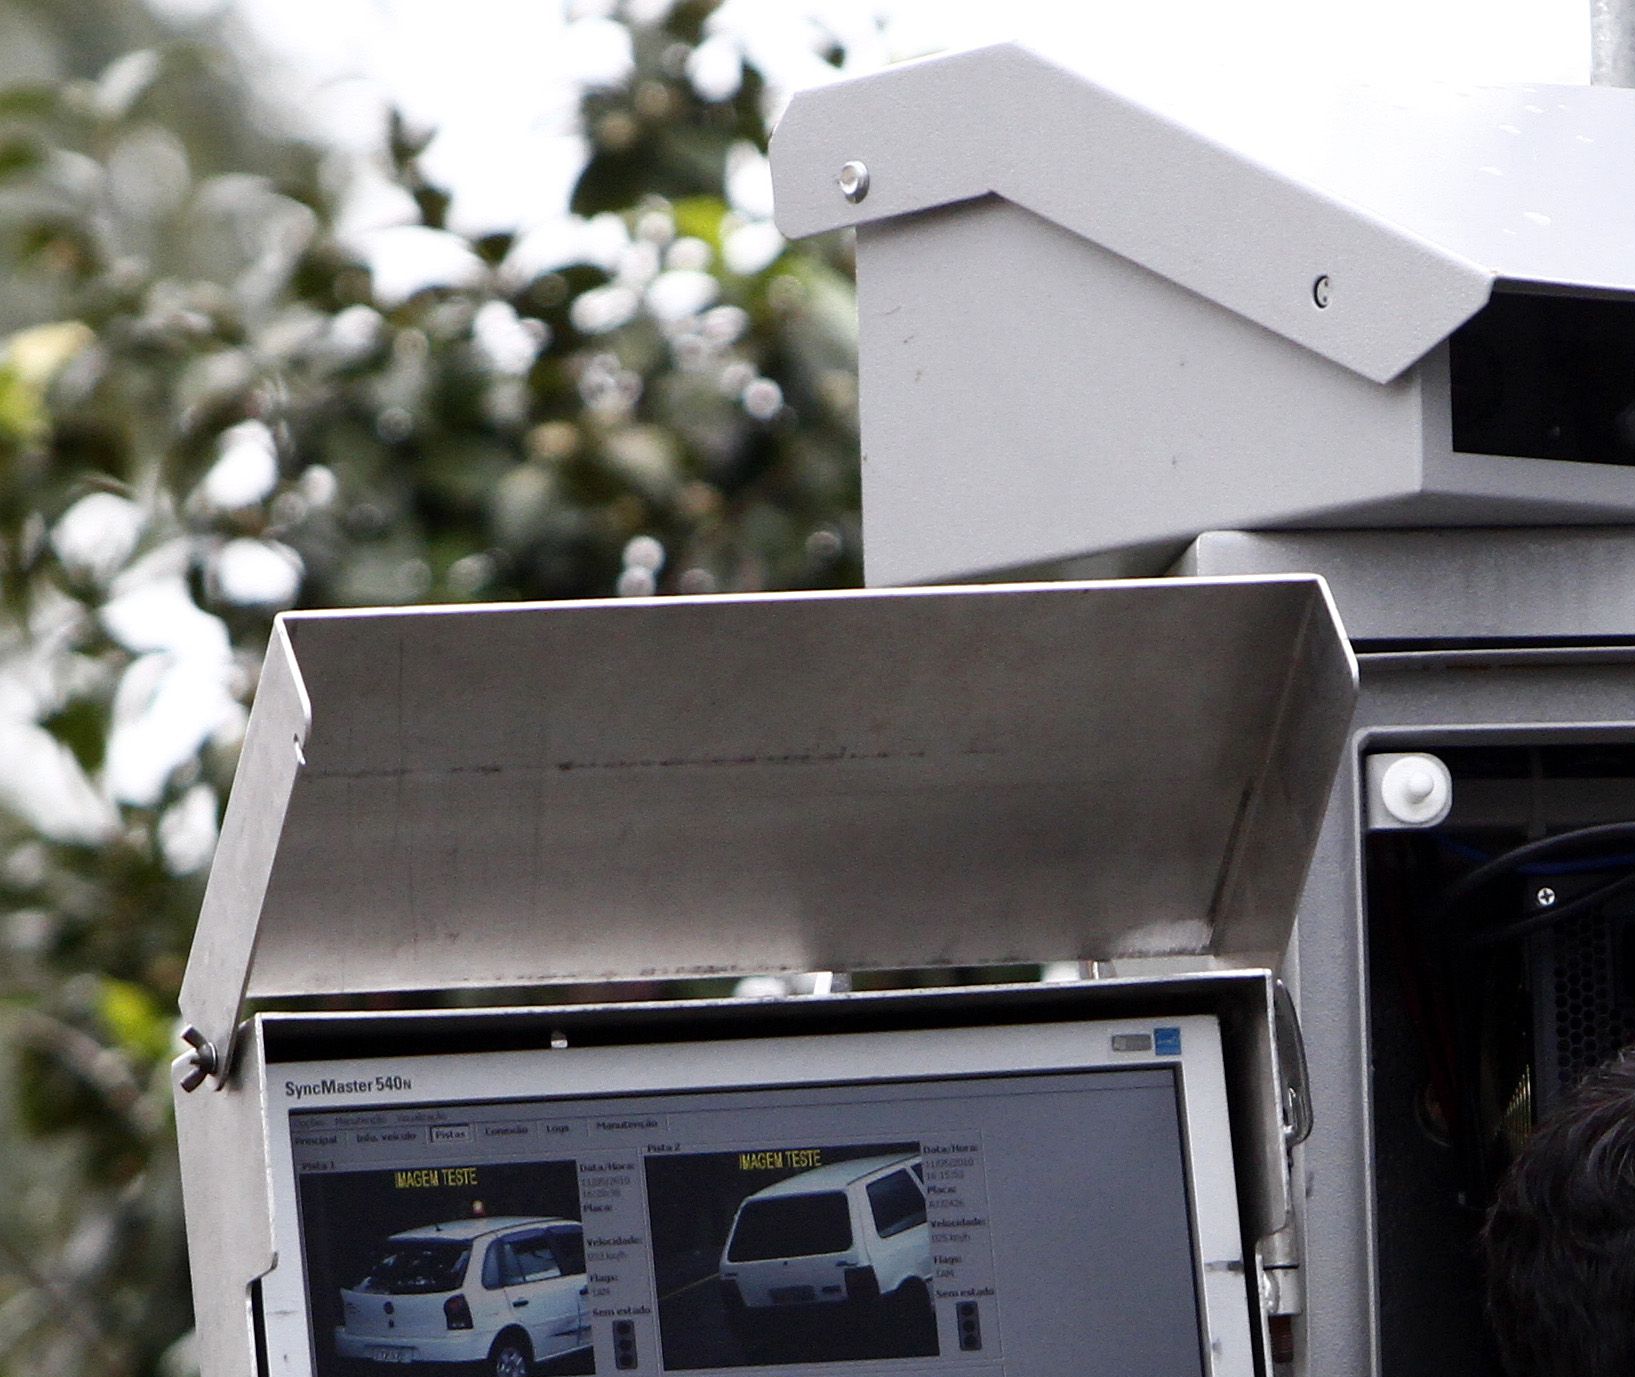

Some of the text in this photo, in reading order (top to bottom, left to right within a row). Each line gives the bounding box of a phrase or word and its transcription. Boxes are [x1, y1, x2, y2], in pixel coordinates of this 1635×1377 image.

[285, 1079, 373, 1098] SyncMaster
[435, 1131, 466, 1140] Pistas
[647, 1144, 673, 1153] Pista
[739, 1150, 822, 1170] IMAGEM TESTE
[395, 1167, 479, 1188] IMAGEM TESTE
